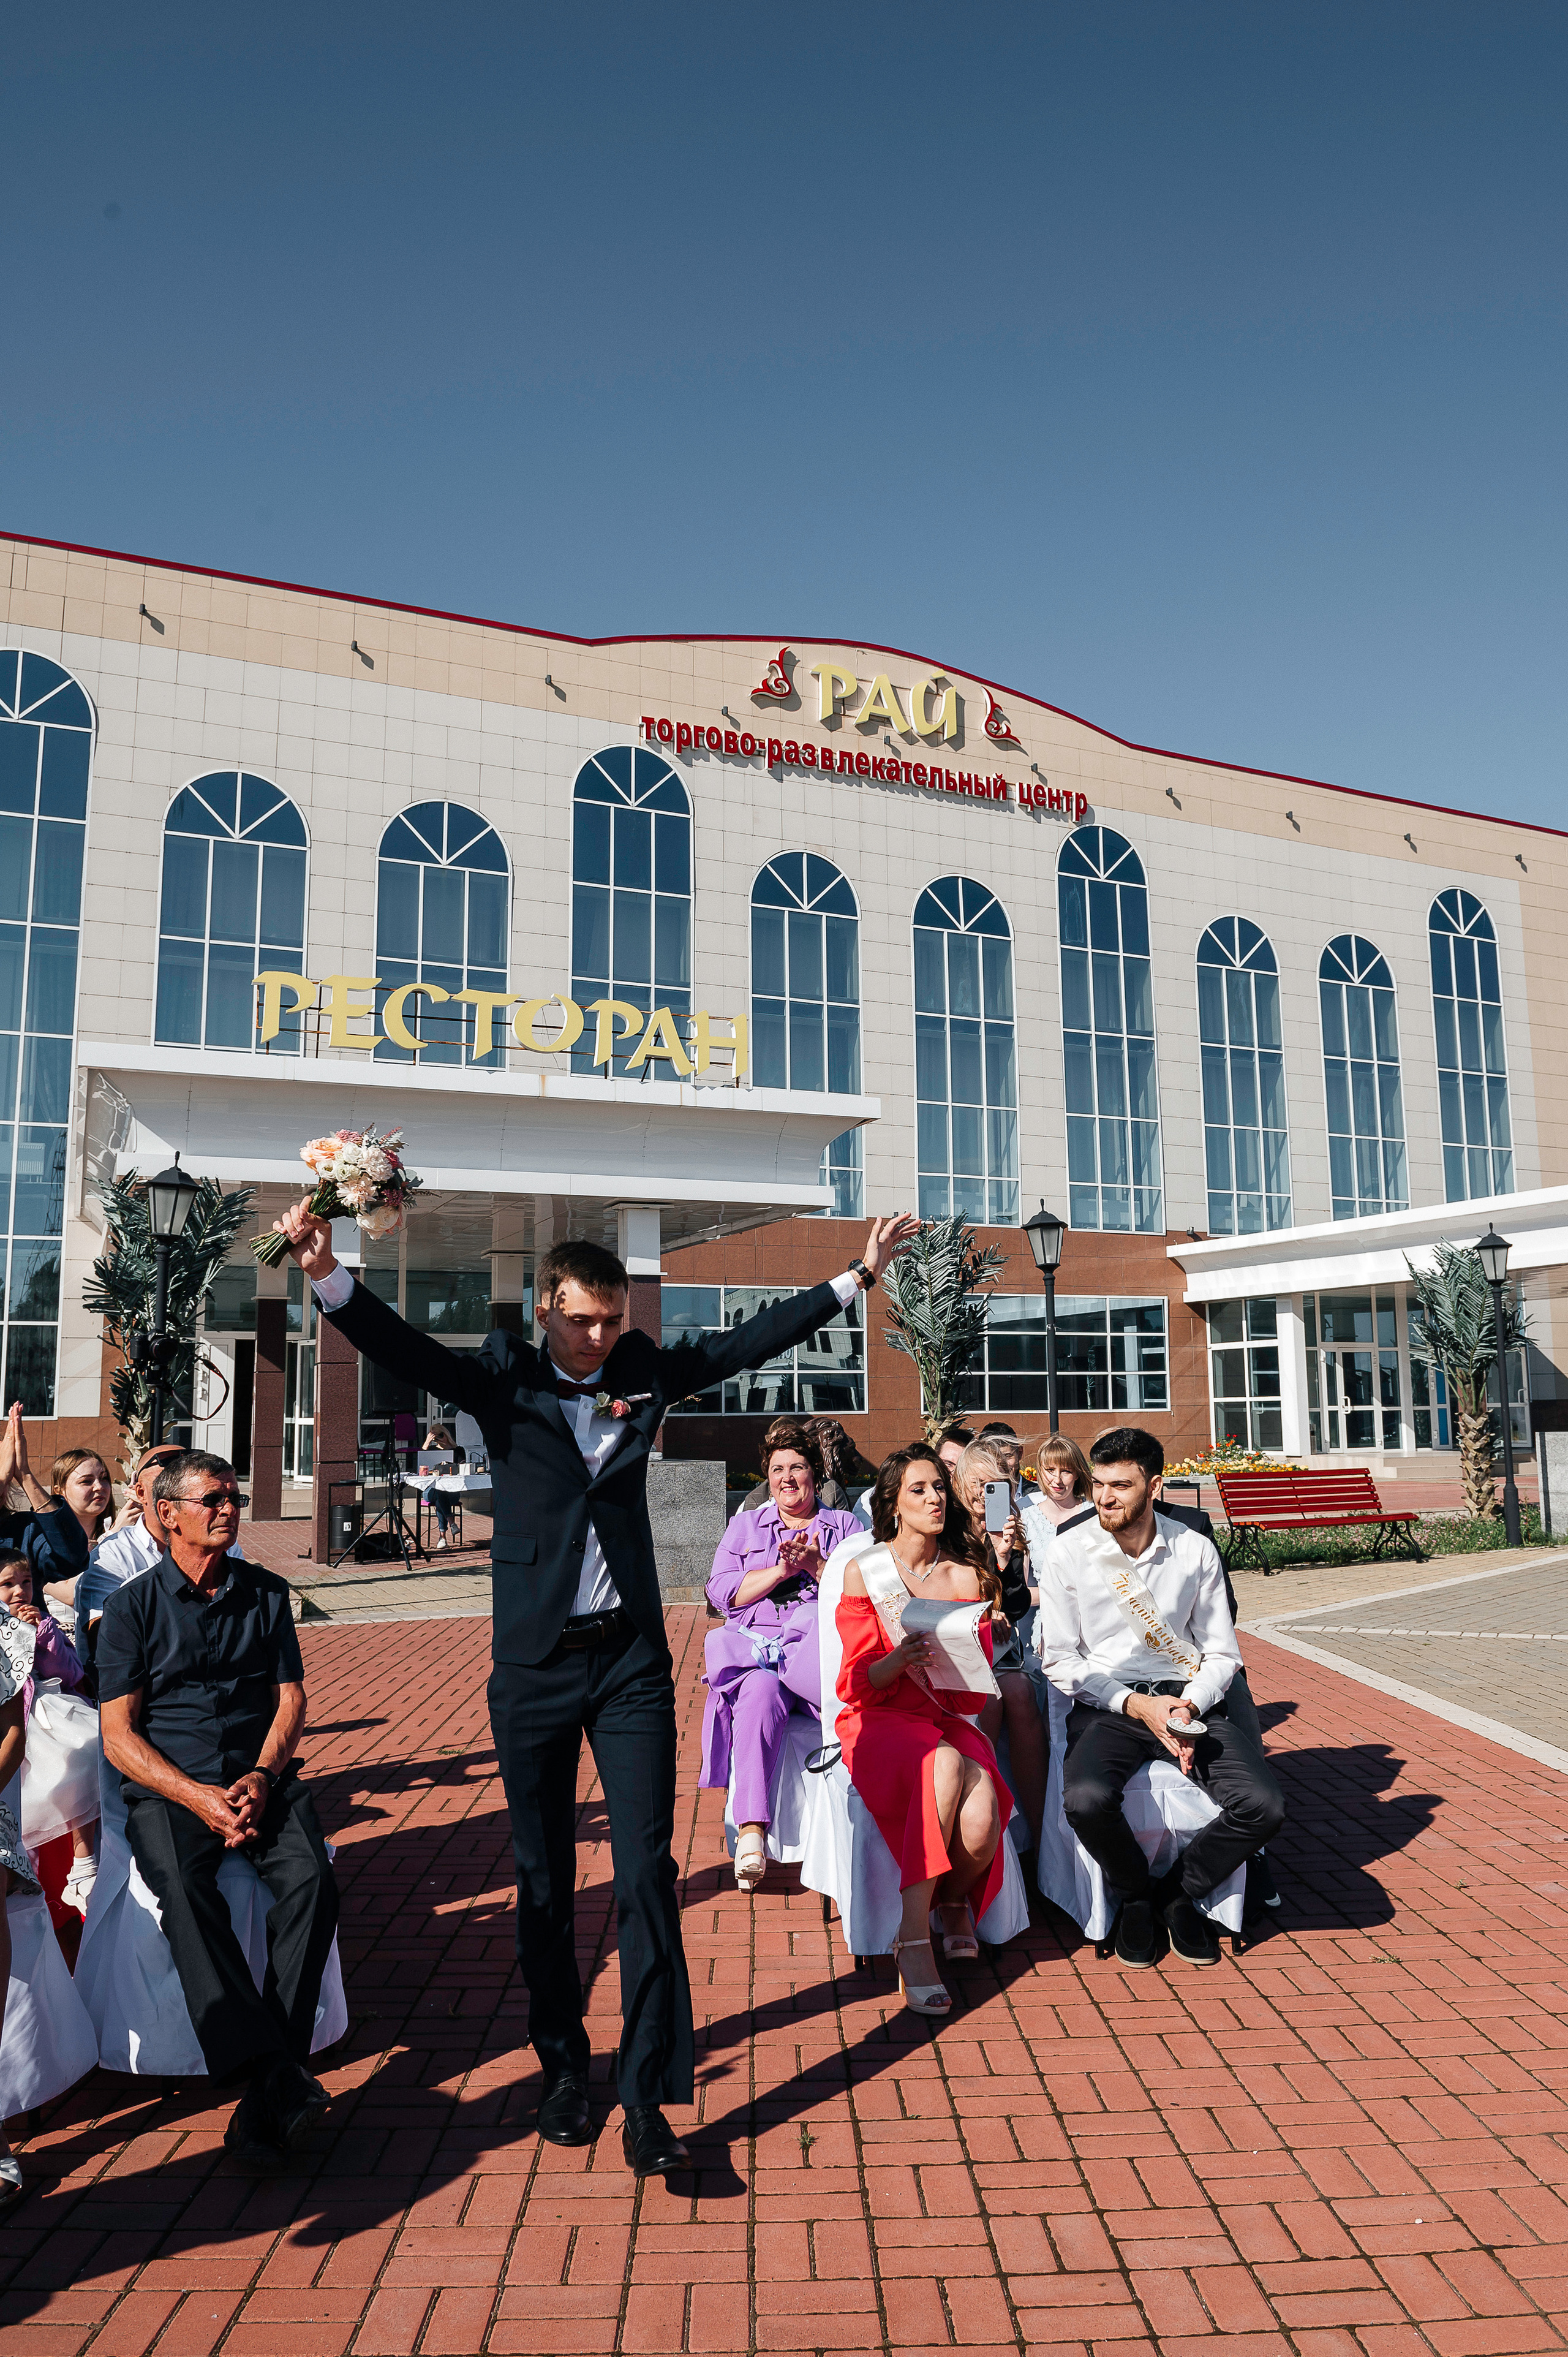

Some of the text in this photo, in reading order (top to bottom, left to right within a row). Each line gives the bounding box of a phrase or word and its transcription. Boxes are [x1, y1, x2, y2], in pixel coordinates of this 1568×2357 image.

[809, 664, 957, 741] РАЙ
[639, 716, 1088, 822] торгово-развлекательный центр
[252, 970, 749, 1080] РЕСТОРАН
